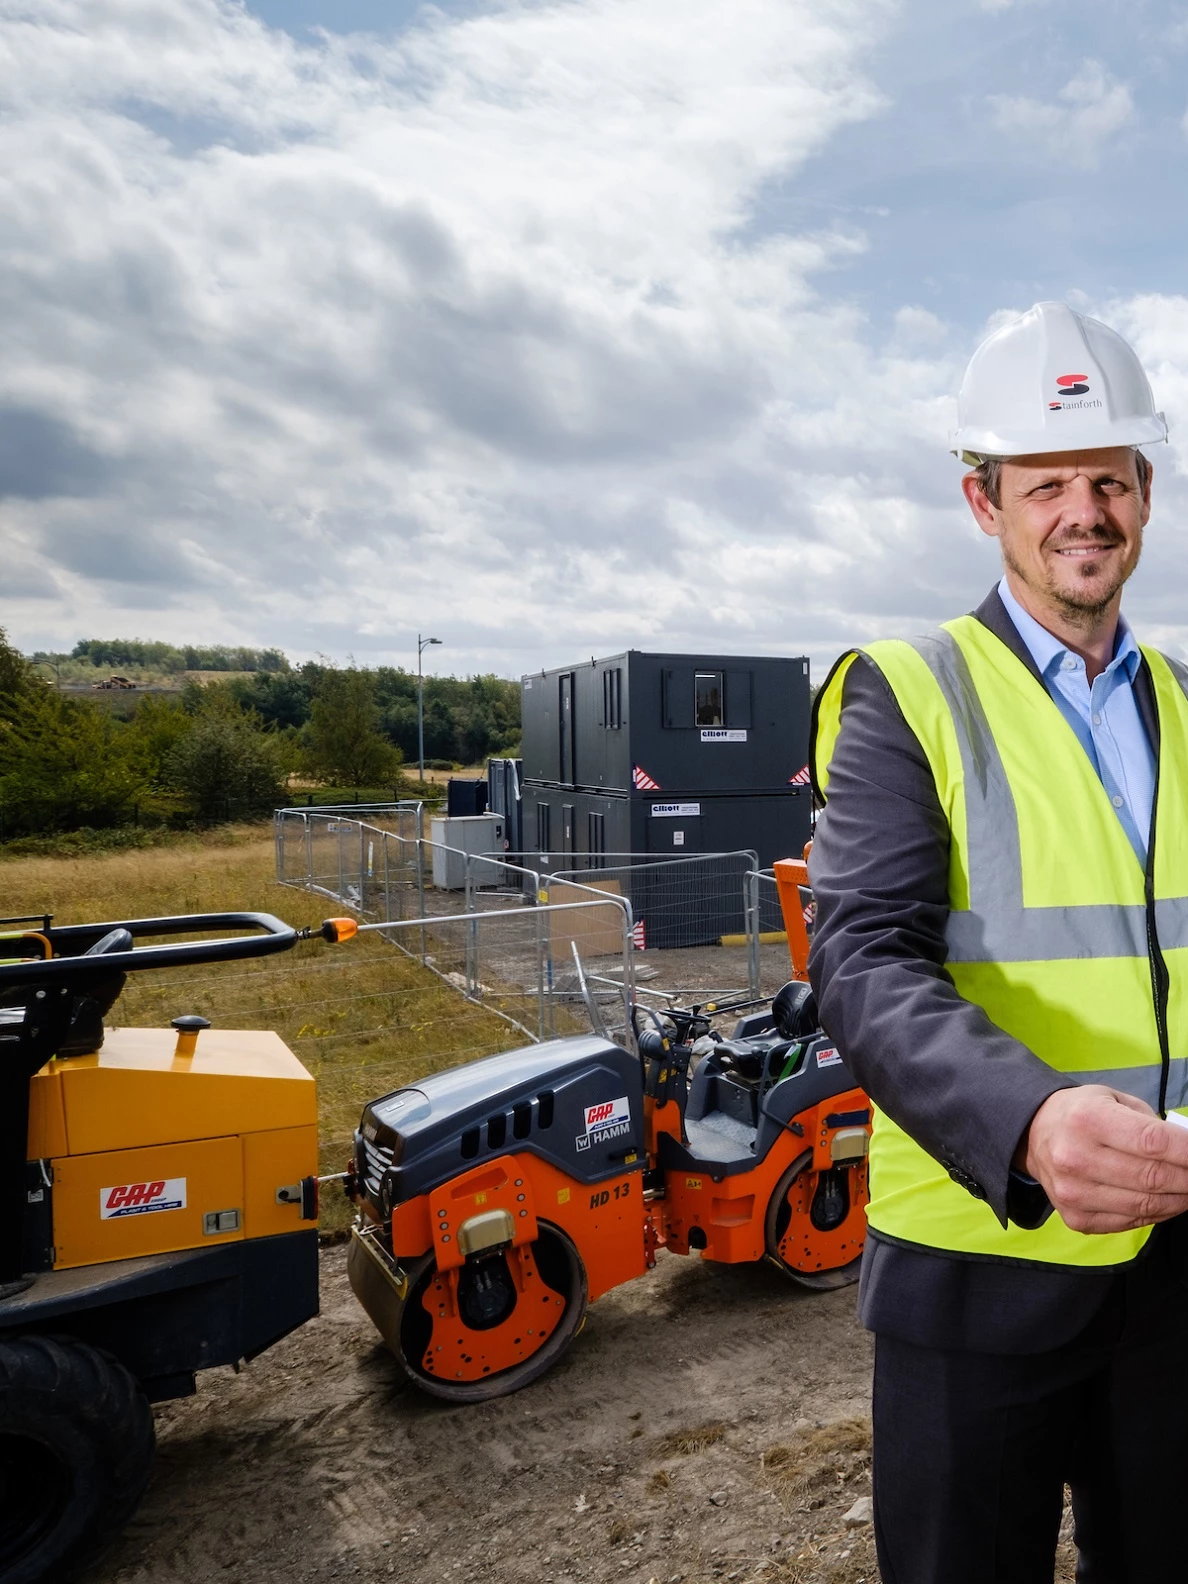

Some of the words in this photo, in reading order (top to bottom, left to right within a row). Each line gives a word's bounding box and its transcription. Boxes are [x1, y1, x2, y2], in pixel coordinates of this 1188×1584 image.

[1048, 399, 1103, 411] Stainforth
[702, 730, 728, 738] elliott
[587, 1102, 614, 1125] GAP
[593, 1122, 630, 1144] HAMM
[105, 1181, 166, 1209] GAP
[589, 1190, 610, 1210] HD
[613, 1182, 630, 1200] 13
